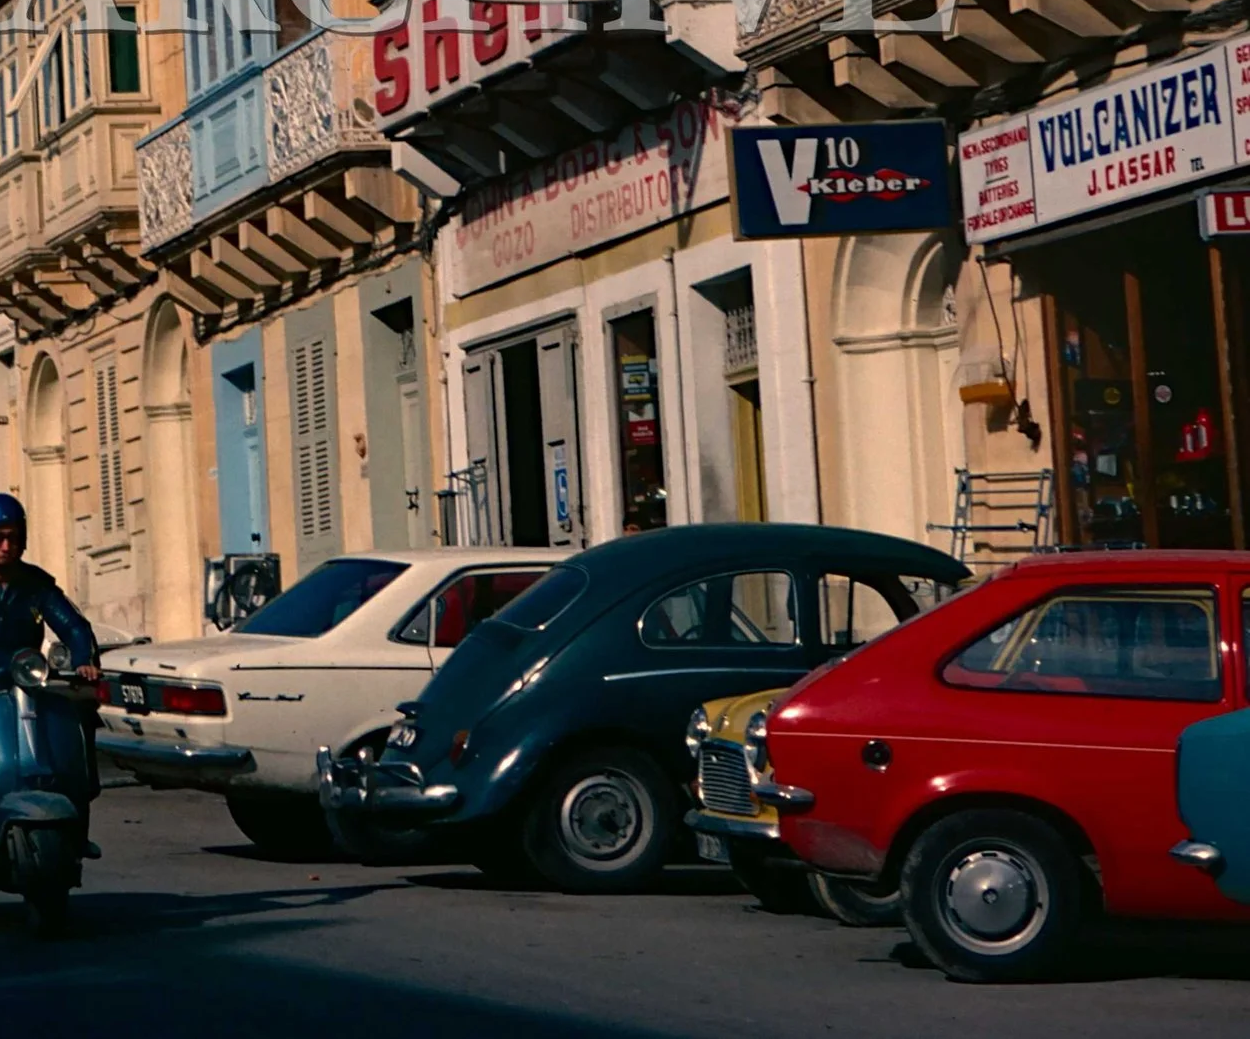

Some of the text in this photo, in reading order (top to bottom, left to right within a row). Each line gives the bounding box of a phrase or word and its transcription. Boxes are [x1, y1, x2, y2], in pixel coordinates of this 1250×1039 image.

[1038, 63, 1221, 173] VULCANIZER
[543, 139, 622, 201] BORG
[808, 175, 922, 195] Kleber
[984, 156, 1008, 178] TYRES
[1105, 146, 1176, 191] CASSAR
[979, 180, 1019, 207] BATTERIES
[493, 220, 535, 268] GOZO
